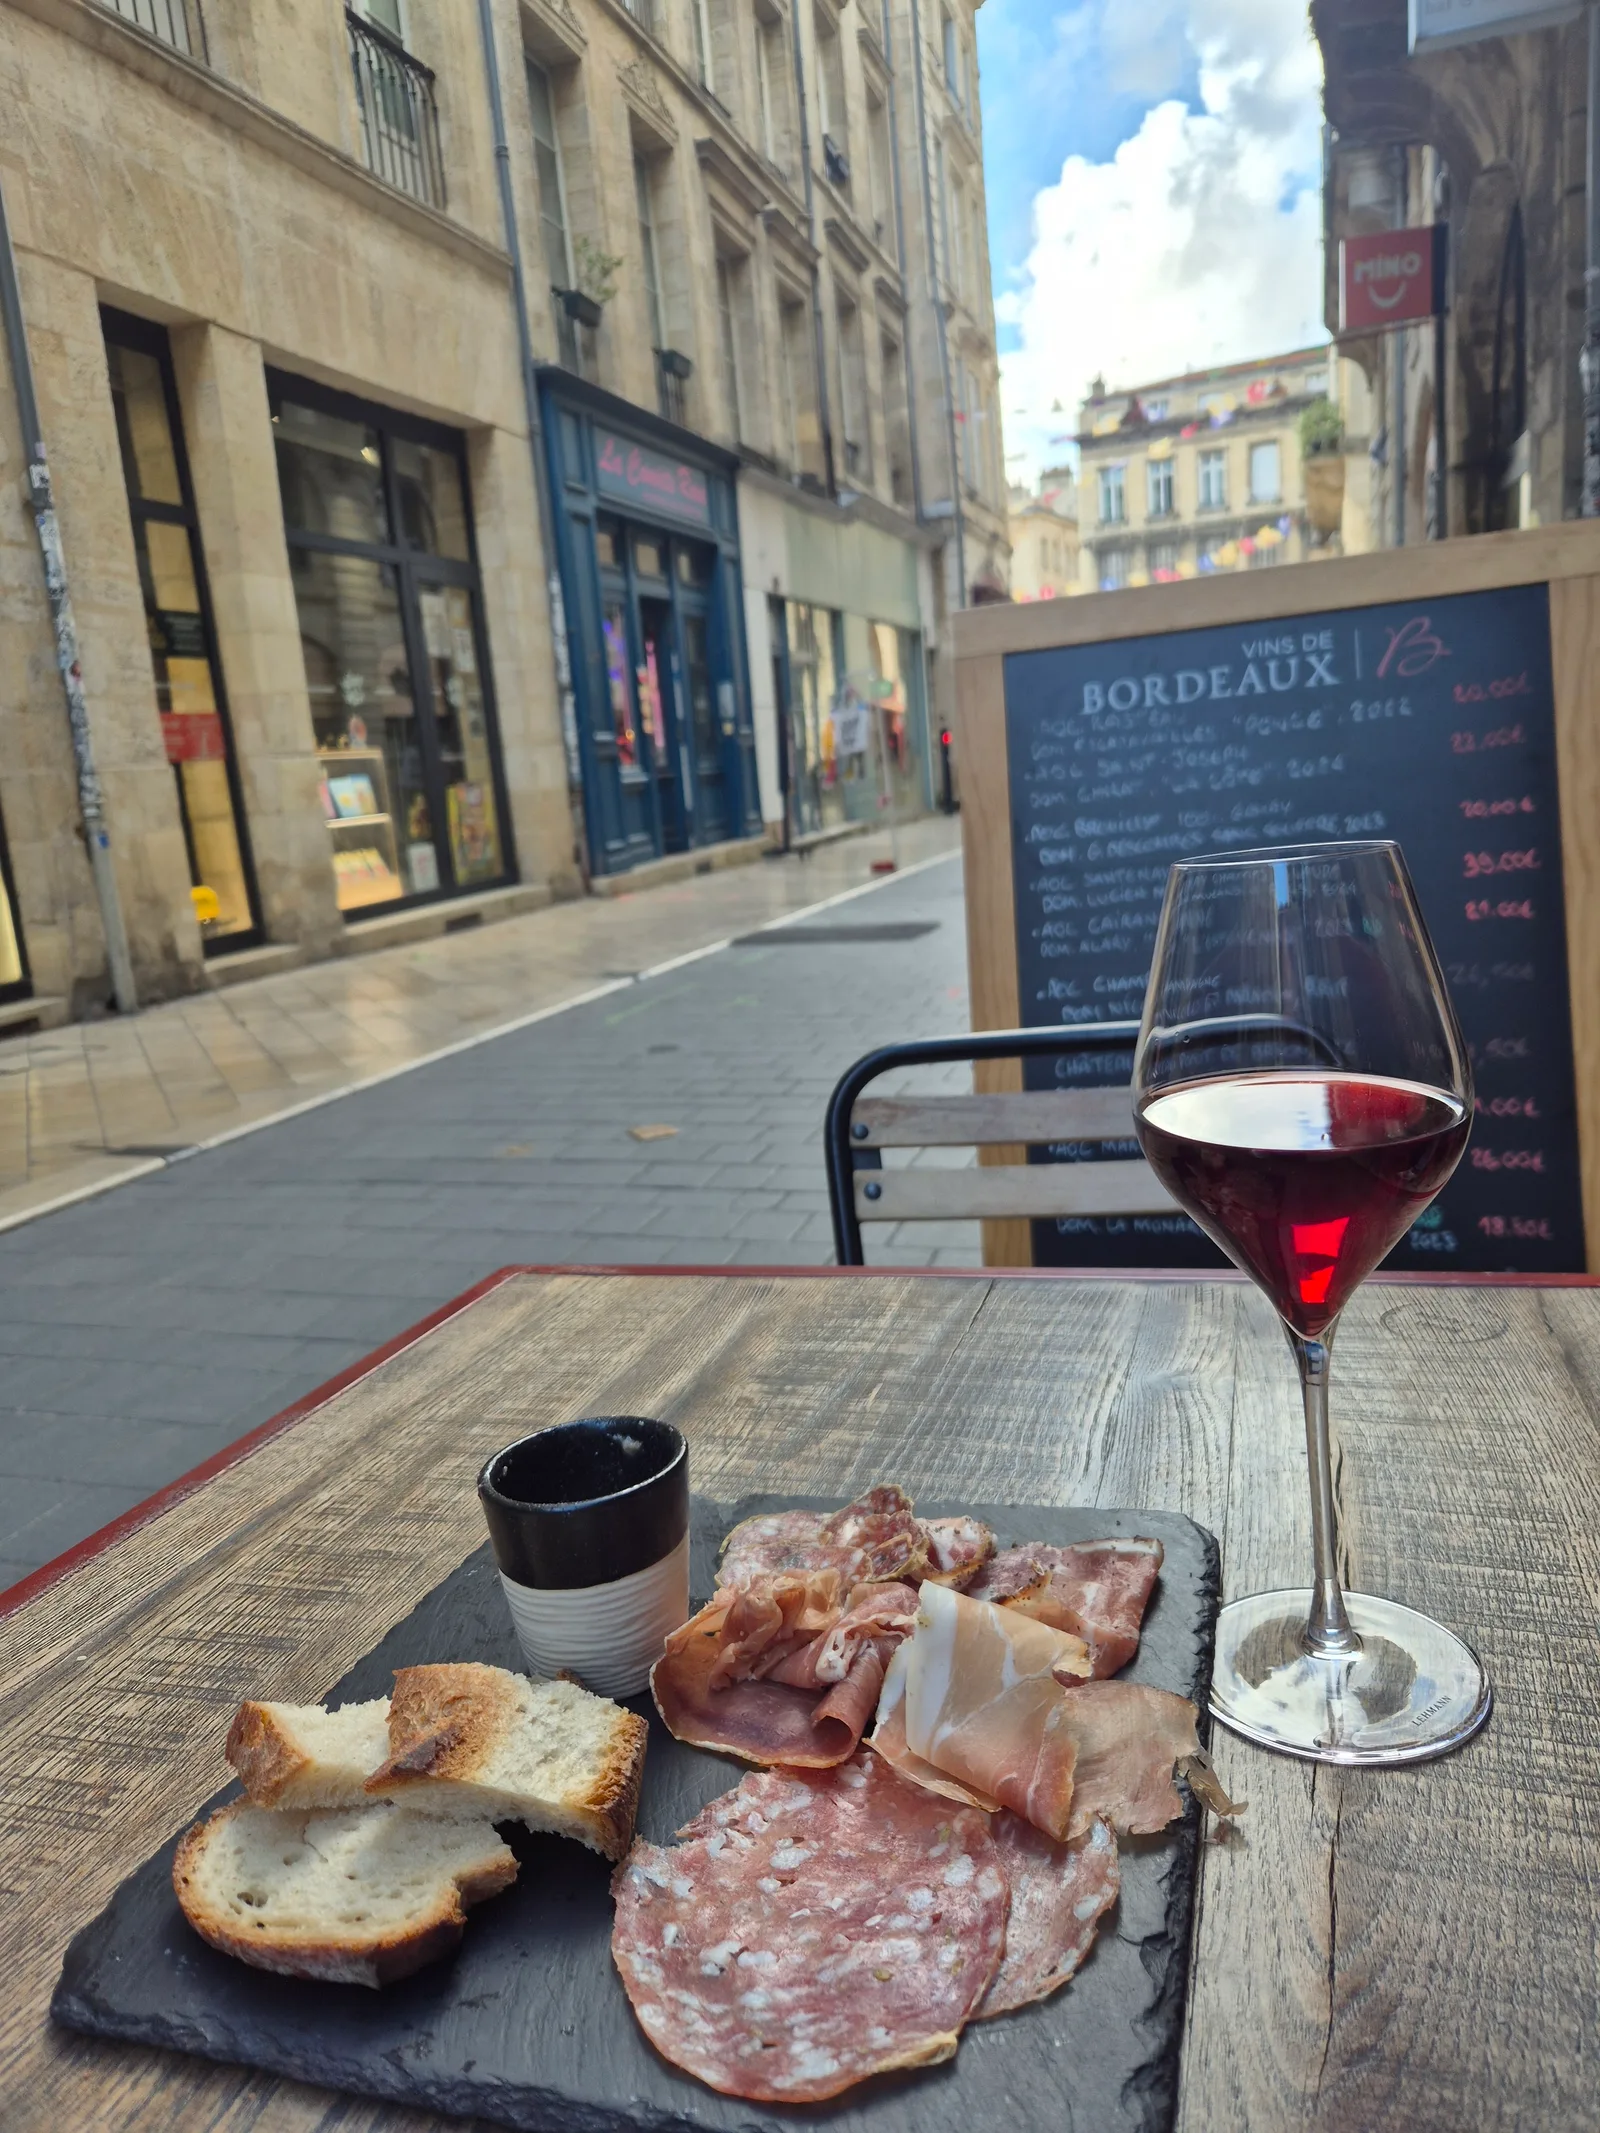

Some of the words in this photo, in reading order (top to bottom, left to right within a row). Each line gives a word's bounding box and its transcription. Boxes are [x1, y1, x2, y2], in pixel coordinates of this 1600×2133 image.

[1241, 636, 1294, 659] VINS
[1302, 630, 1334, 651] DE
[1080, 652, 1341, 715] BORDEAUX
[1412, 1695, 1453, 1727] LEHMANN
